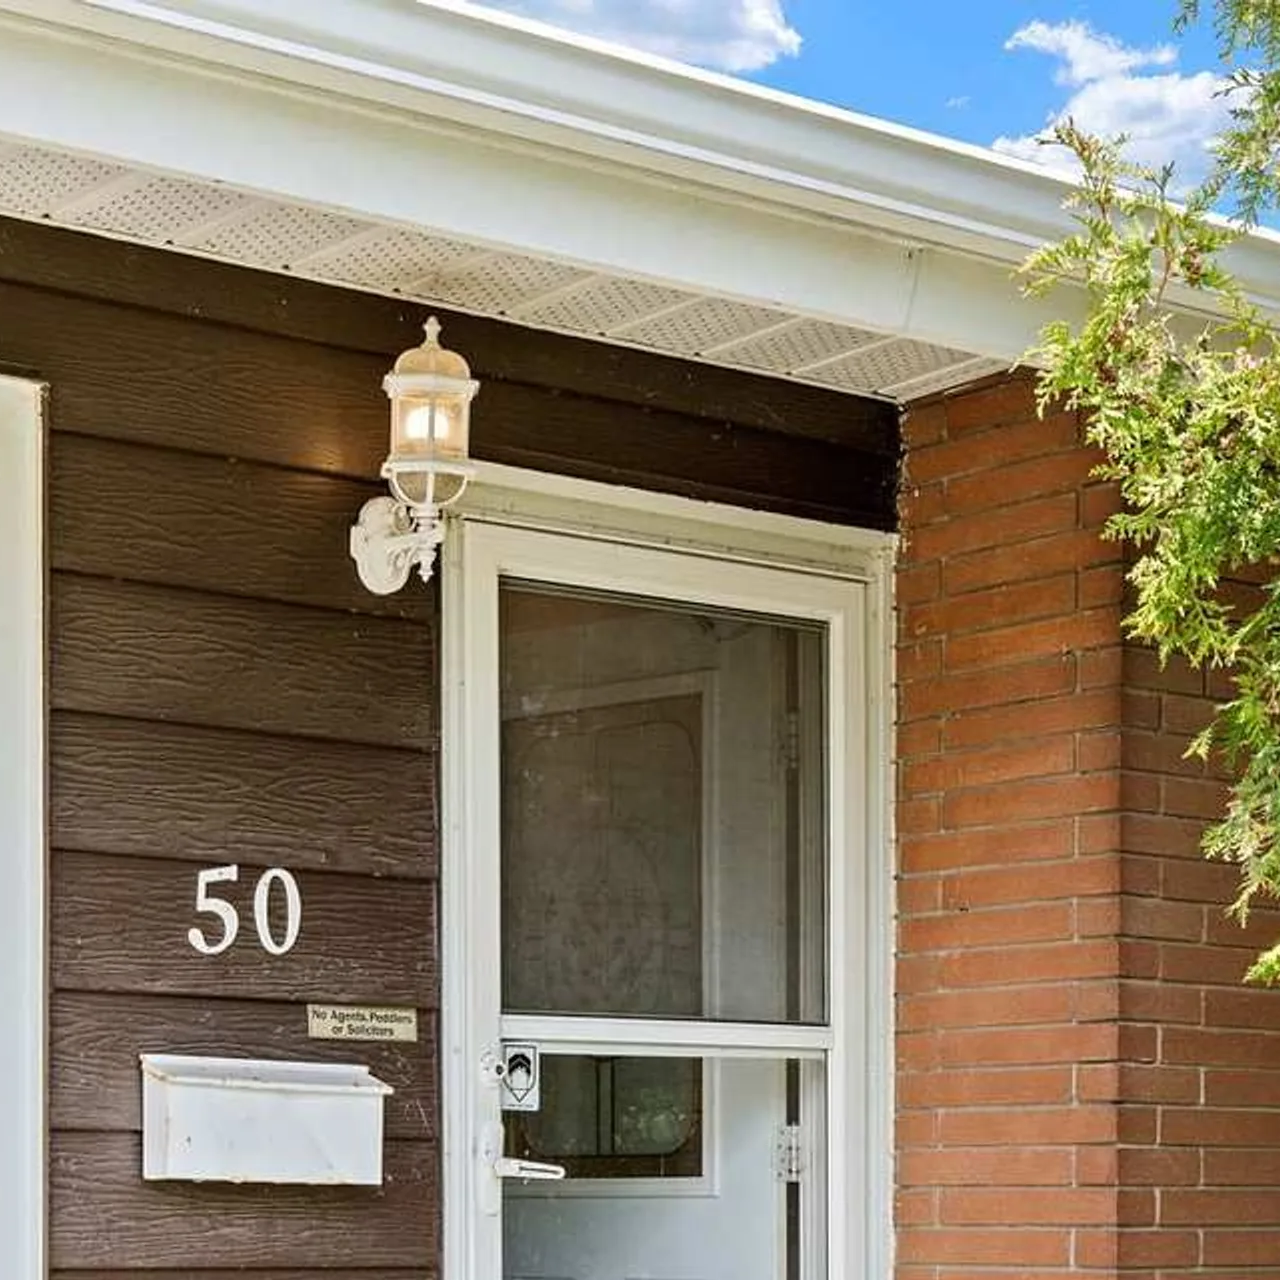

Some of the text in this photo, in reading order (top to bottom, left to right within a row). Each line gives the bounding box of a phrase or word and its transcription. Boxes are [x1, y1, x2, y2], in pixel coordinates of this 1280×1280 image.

[187, 864, 302, 955] 50
[312, 1009, 328, 1021] No
[331, 1026, 344, 1035] or
